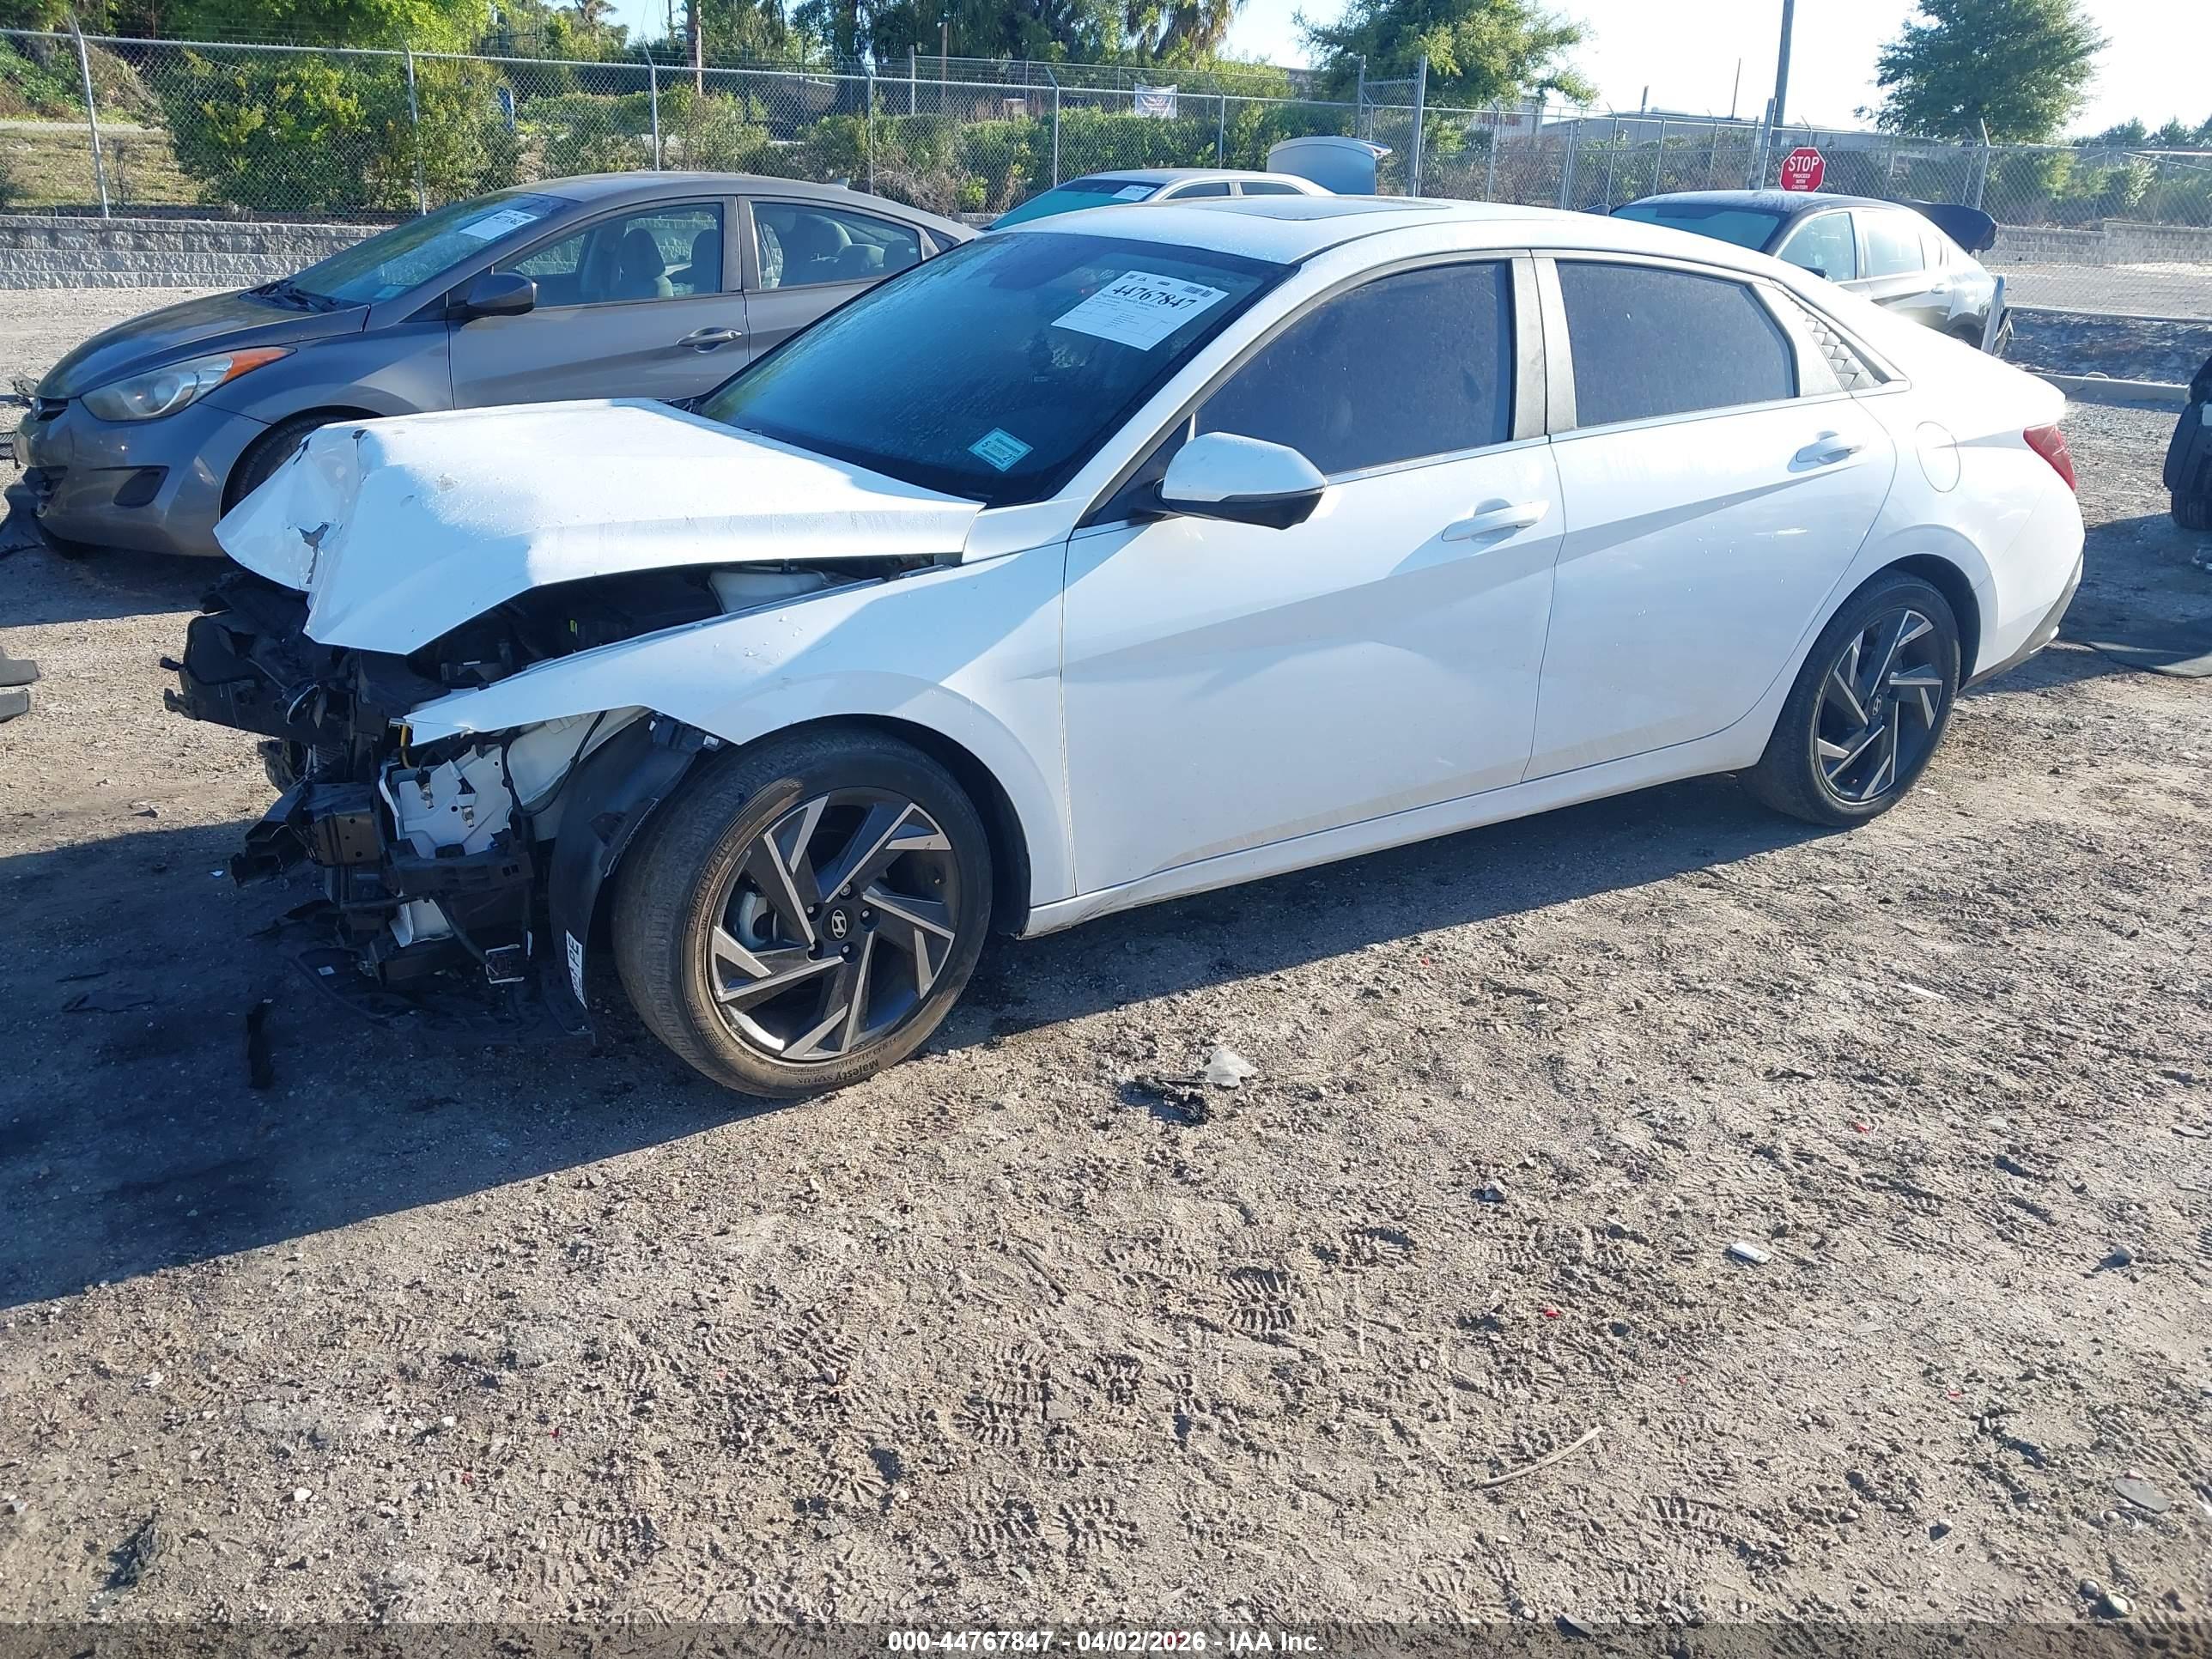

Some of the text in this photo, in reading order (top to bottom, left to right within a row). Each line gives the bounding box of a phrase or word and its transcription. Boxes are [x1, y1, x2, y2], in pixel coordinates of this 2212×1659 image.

[1788, 156, 1820, 172] STOP
[1112, 284, 1198, 310] 44767847
[836, 1058, 879, 1082] Majesty
